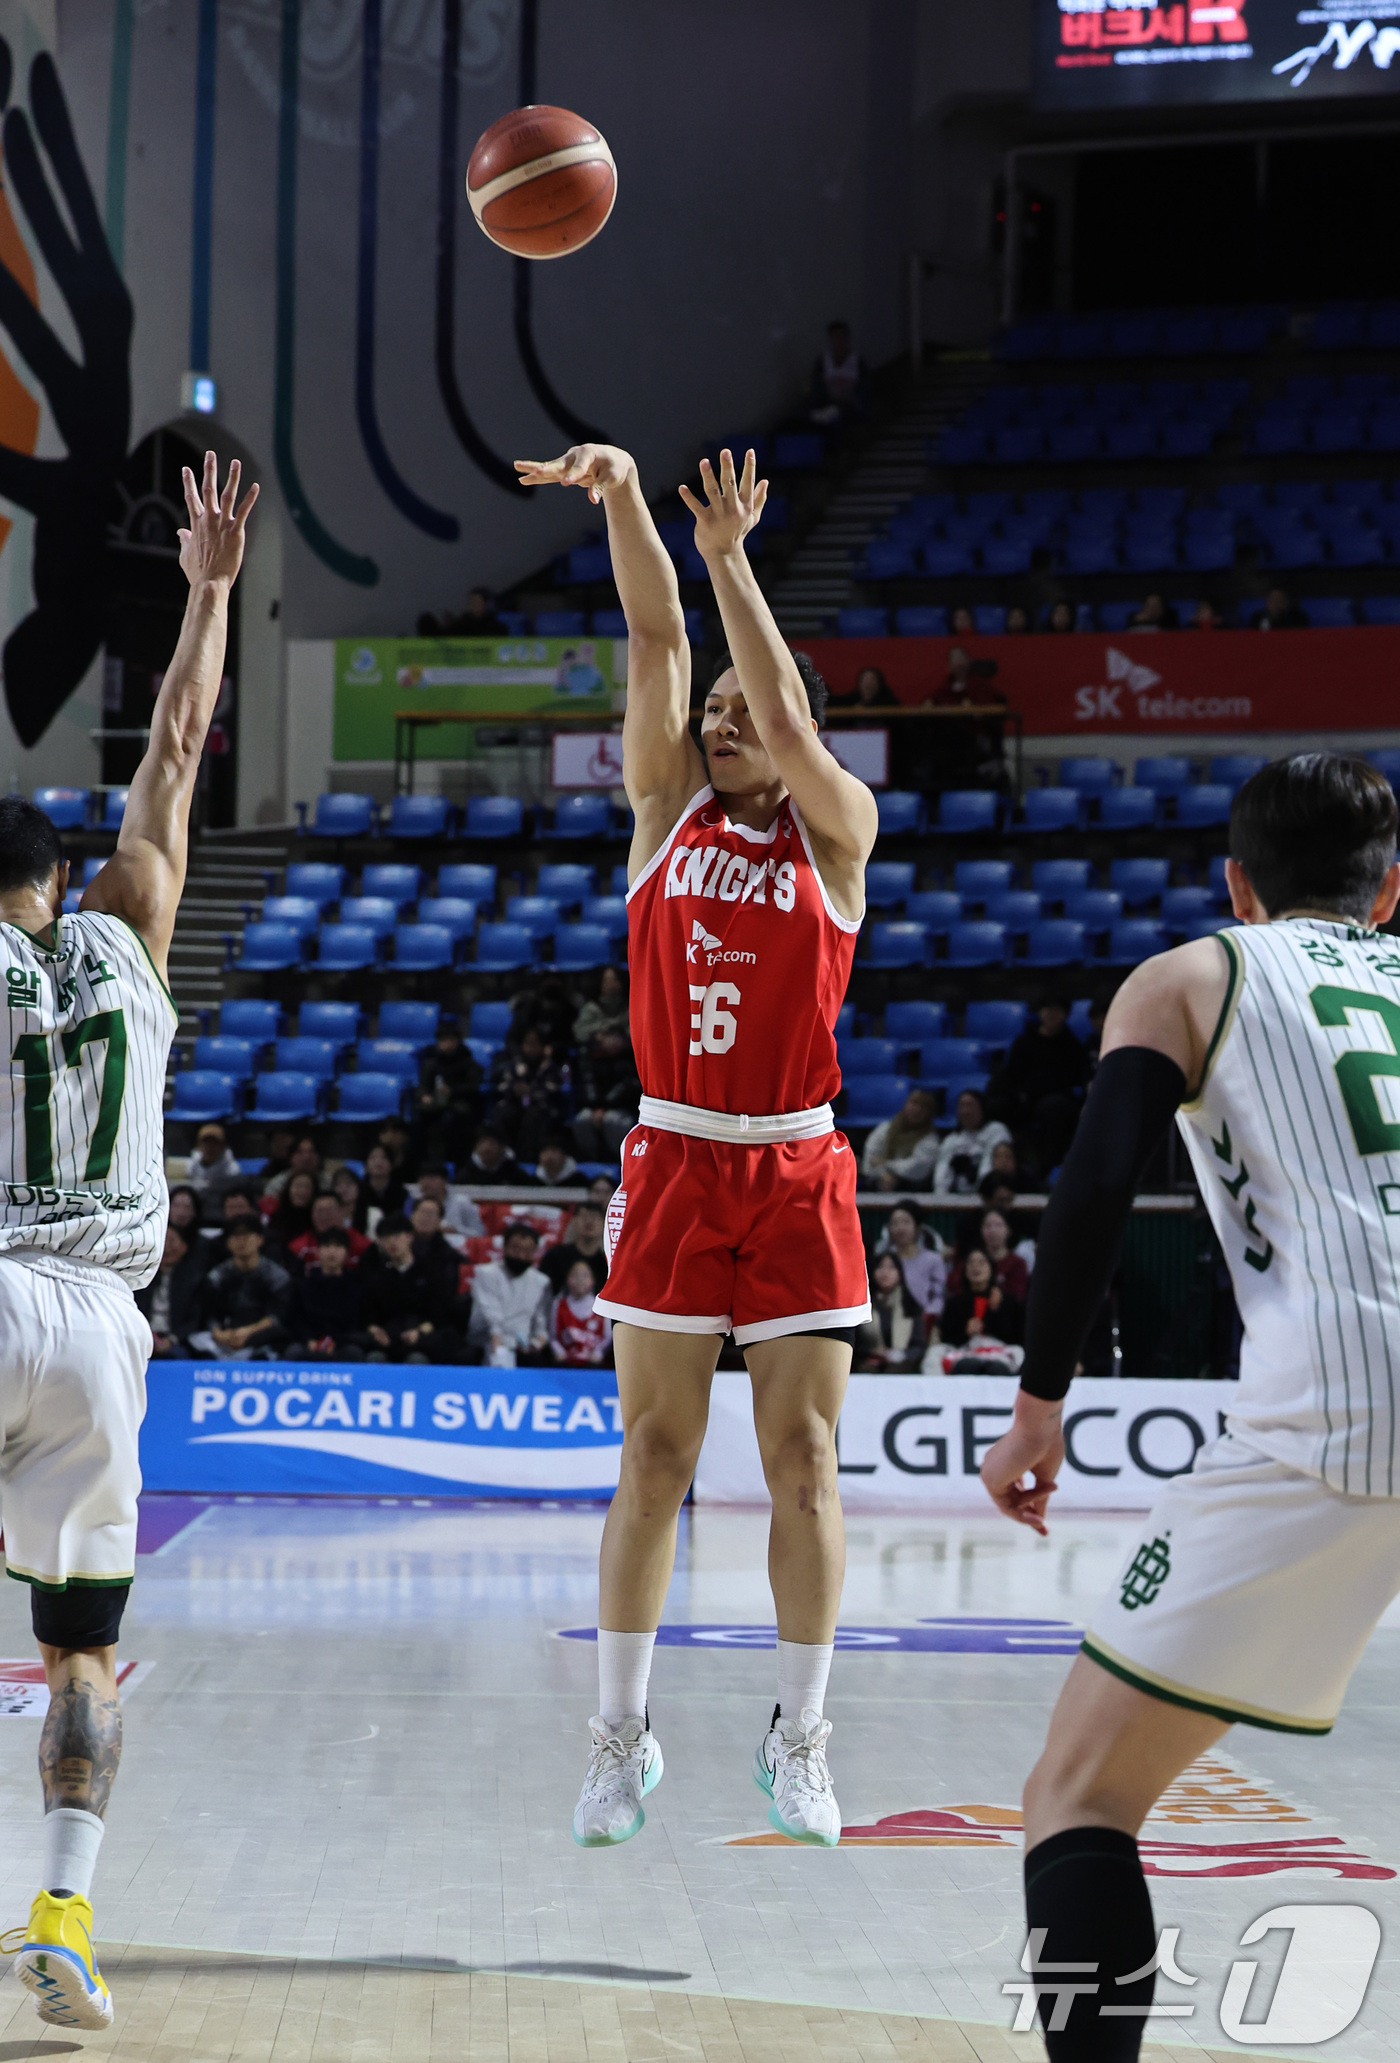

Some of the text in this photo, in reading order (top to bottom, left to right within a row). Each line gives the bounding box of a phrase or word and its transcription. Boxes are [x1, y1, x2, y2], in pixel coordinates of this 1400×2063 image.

[1075, 686, 1251, 720] SK telecom
[686, 942, 700, 964] K
[10, 1007, 127, 1187] 17
[194, 1370, 353, 1385] ION SUPPLY DRINK
[191, 1386, 416, 1427] POCARI
[836, 1405, 1228, 1479] LGECO
[1143, 1755, 1312, 1824] telec
